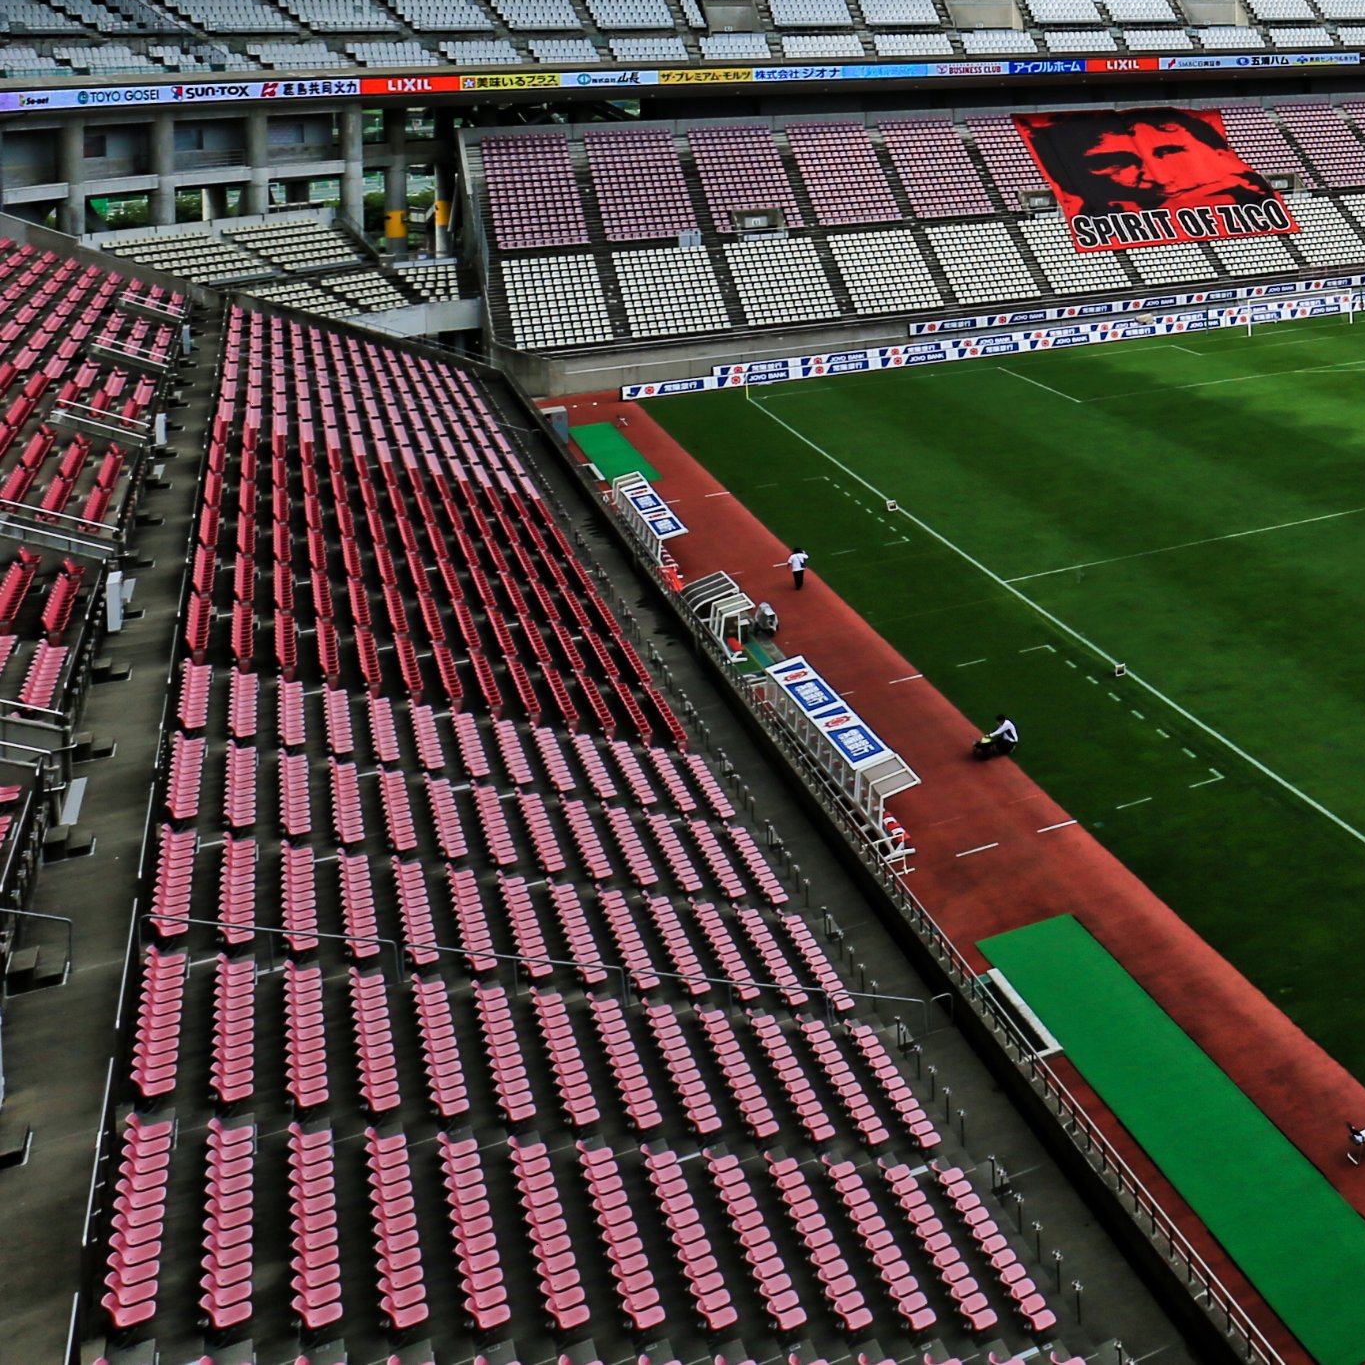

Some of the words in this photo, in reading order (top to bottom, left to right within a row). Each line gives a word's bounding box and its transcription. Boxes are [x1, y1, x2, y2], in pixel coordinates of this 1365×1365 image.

[949, 66, 982, 74] BUSINESS
[984, 65, 1001, 73] CLUB
[1013, 59, 1081, 72] アイフルホーム
[1106, 59, 1140, 70] LIXIL
[387, 78, 432, 91] LIXIL
[90, 91, 121, 104] TOYO
[124, 89, 160, 102] GOSEI
[186, 85, 250, 99] SUN-TOX
[1071, 210, 1178, 248] SPIRIT
[1177, 205, 1216, 238] OF
[1218, 198, 1290, 234] ZICO
[1189, 321, 1204, 329] JOYO
[927, 352, 944, 360] BANK
[749, 373, 766, 381] JOYO
[768, 371, 787, 379] BANK
